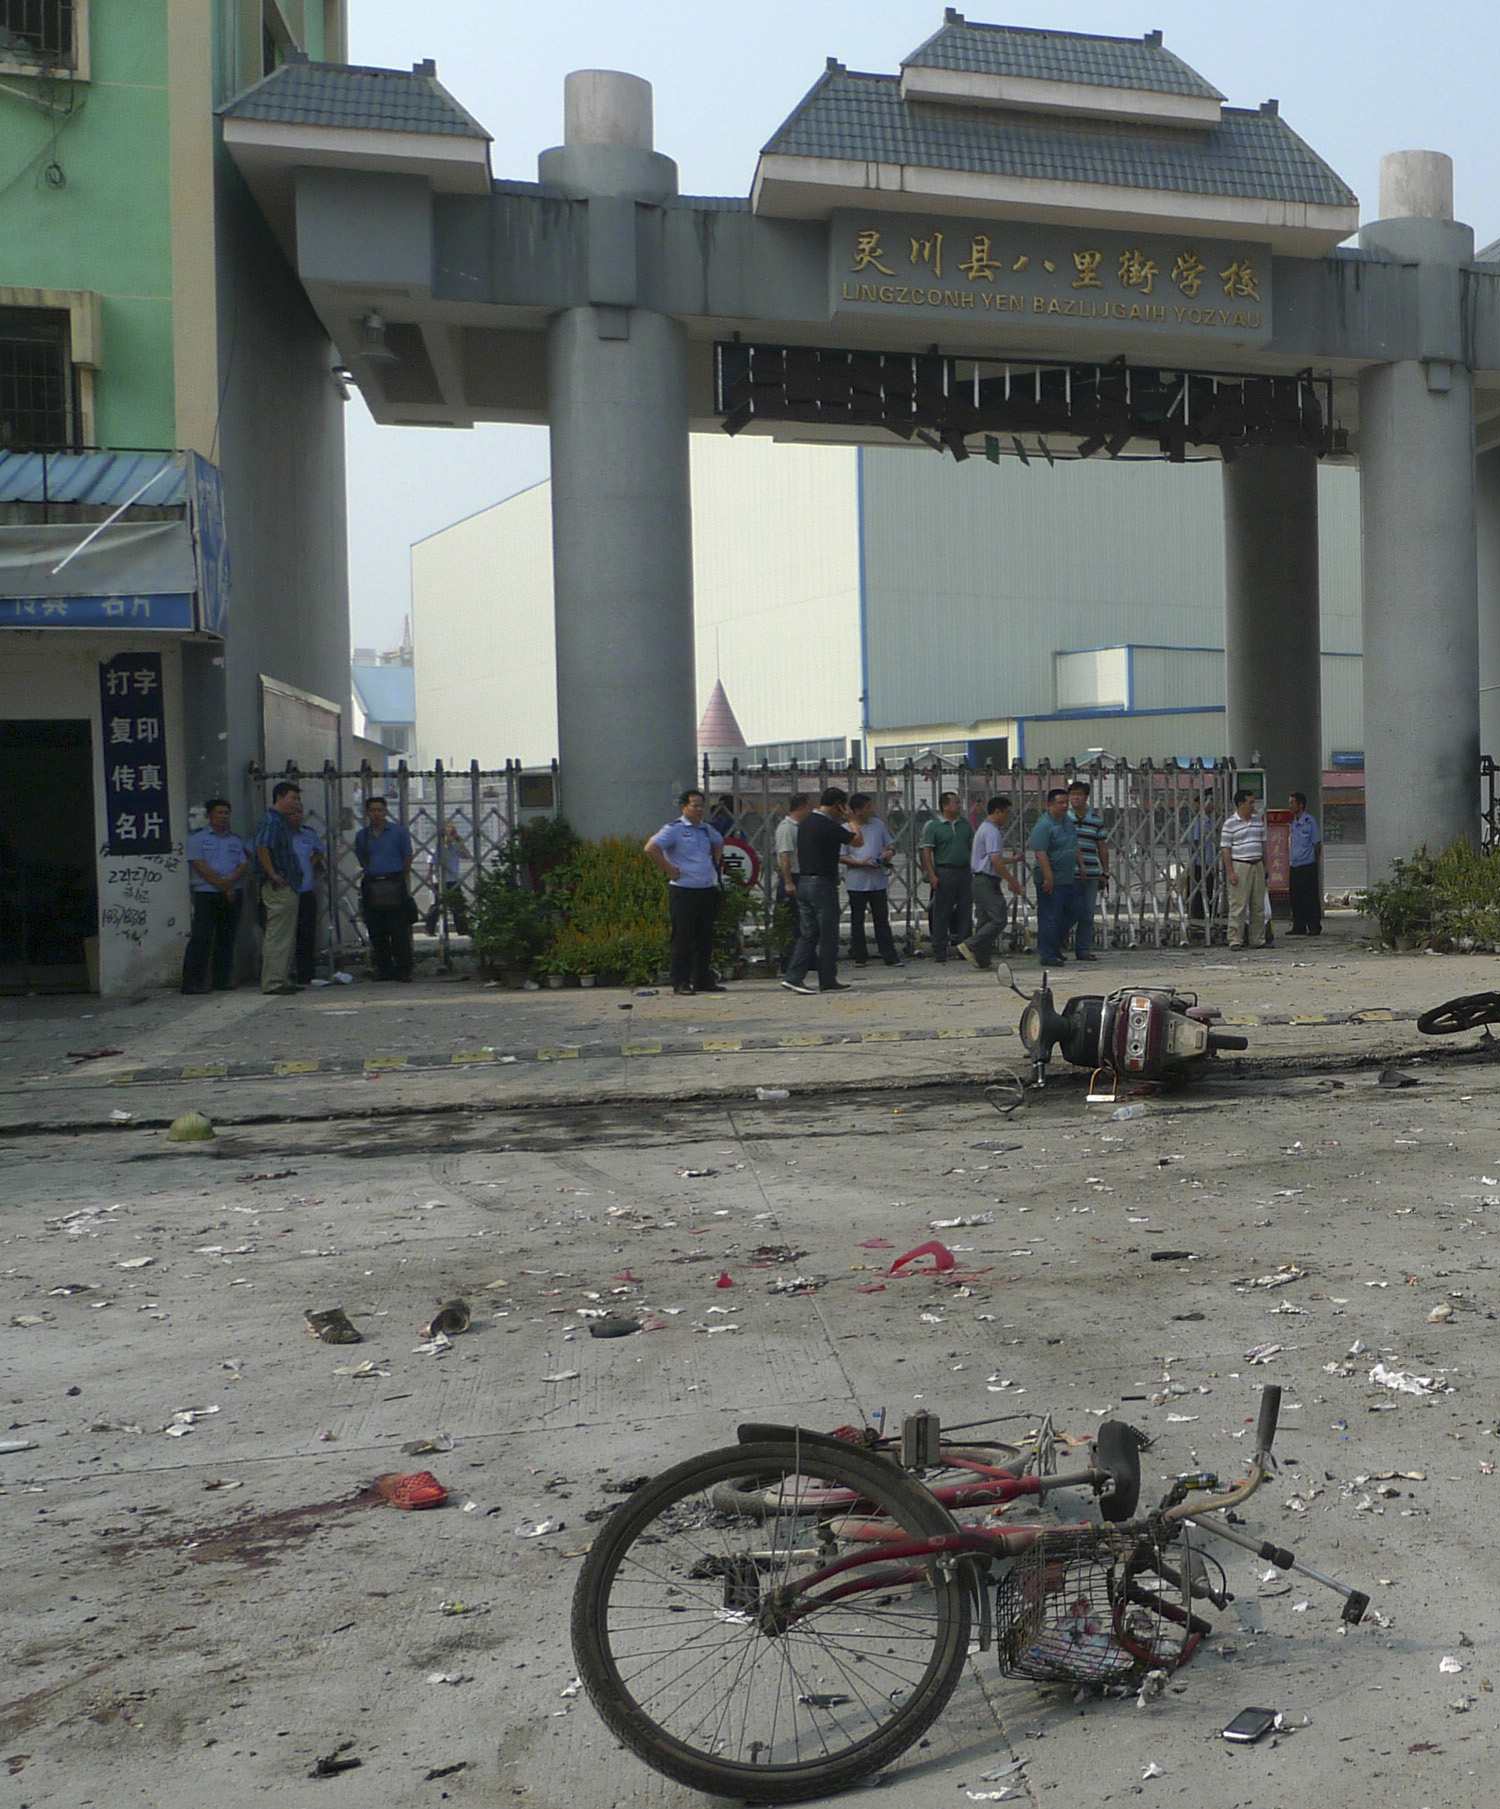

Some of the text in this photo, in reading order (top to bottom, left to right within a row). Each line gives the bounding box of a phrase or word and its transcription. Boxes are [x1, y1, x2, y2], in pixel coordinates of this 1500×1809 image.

[850, 230, 1262, 302] 灵川县八里街学校
[841, 282, 975, 308] LINGZCONH
[981, 292, 1025, 313] YEN
[106, 669, 158, 695] 打字
[110, 717, 160, 744] 复印
[112, 764, 163, 792] 传真
[115, 811, 164, 840] 名片
